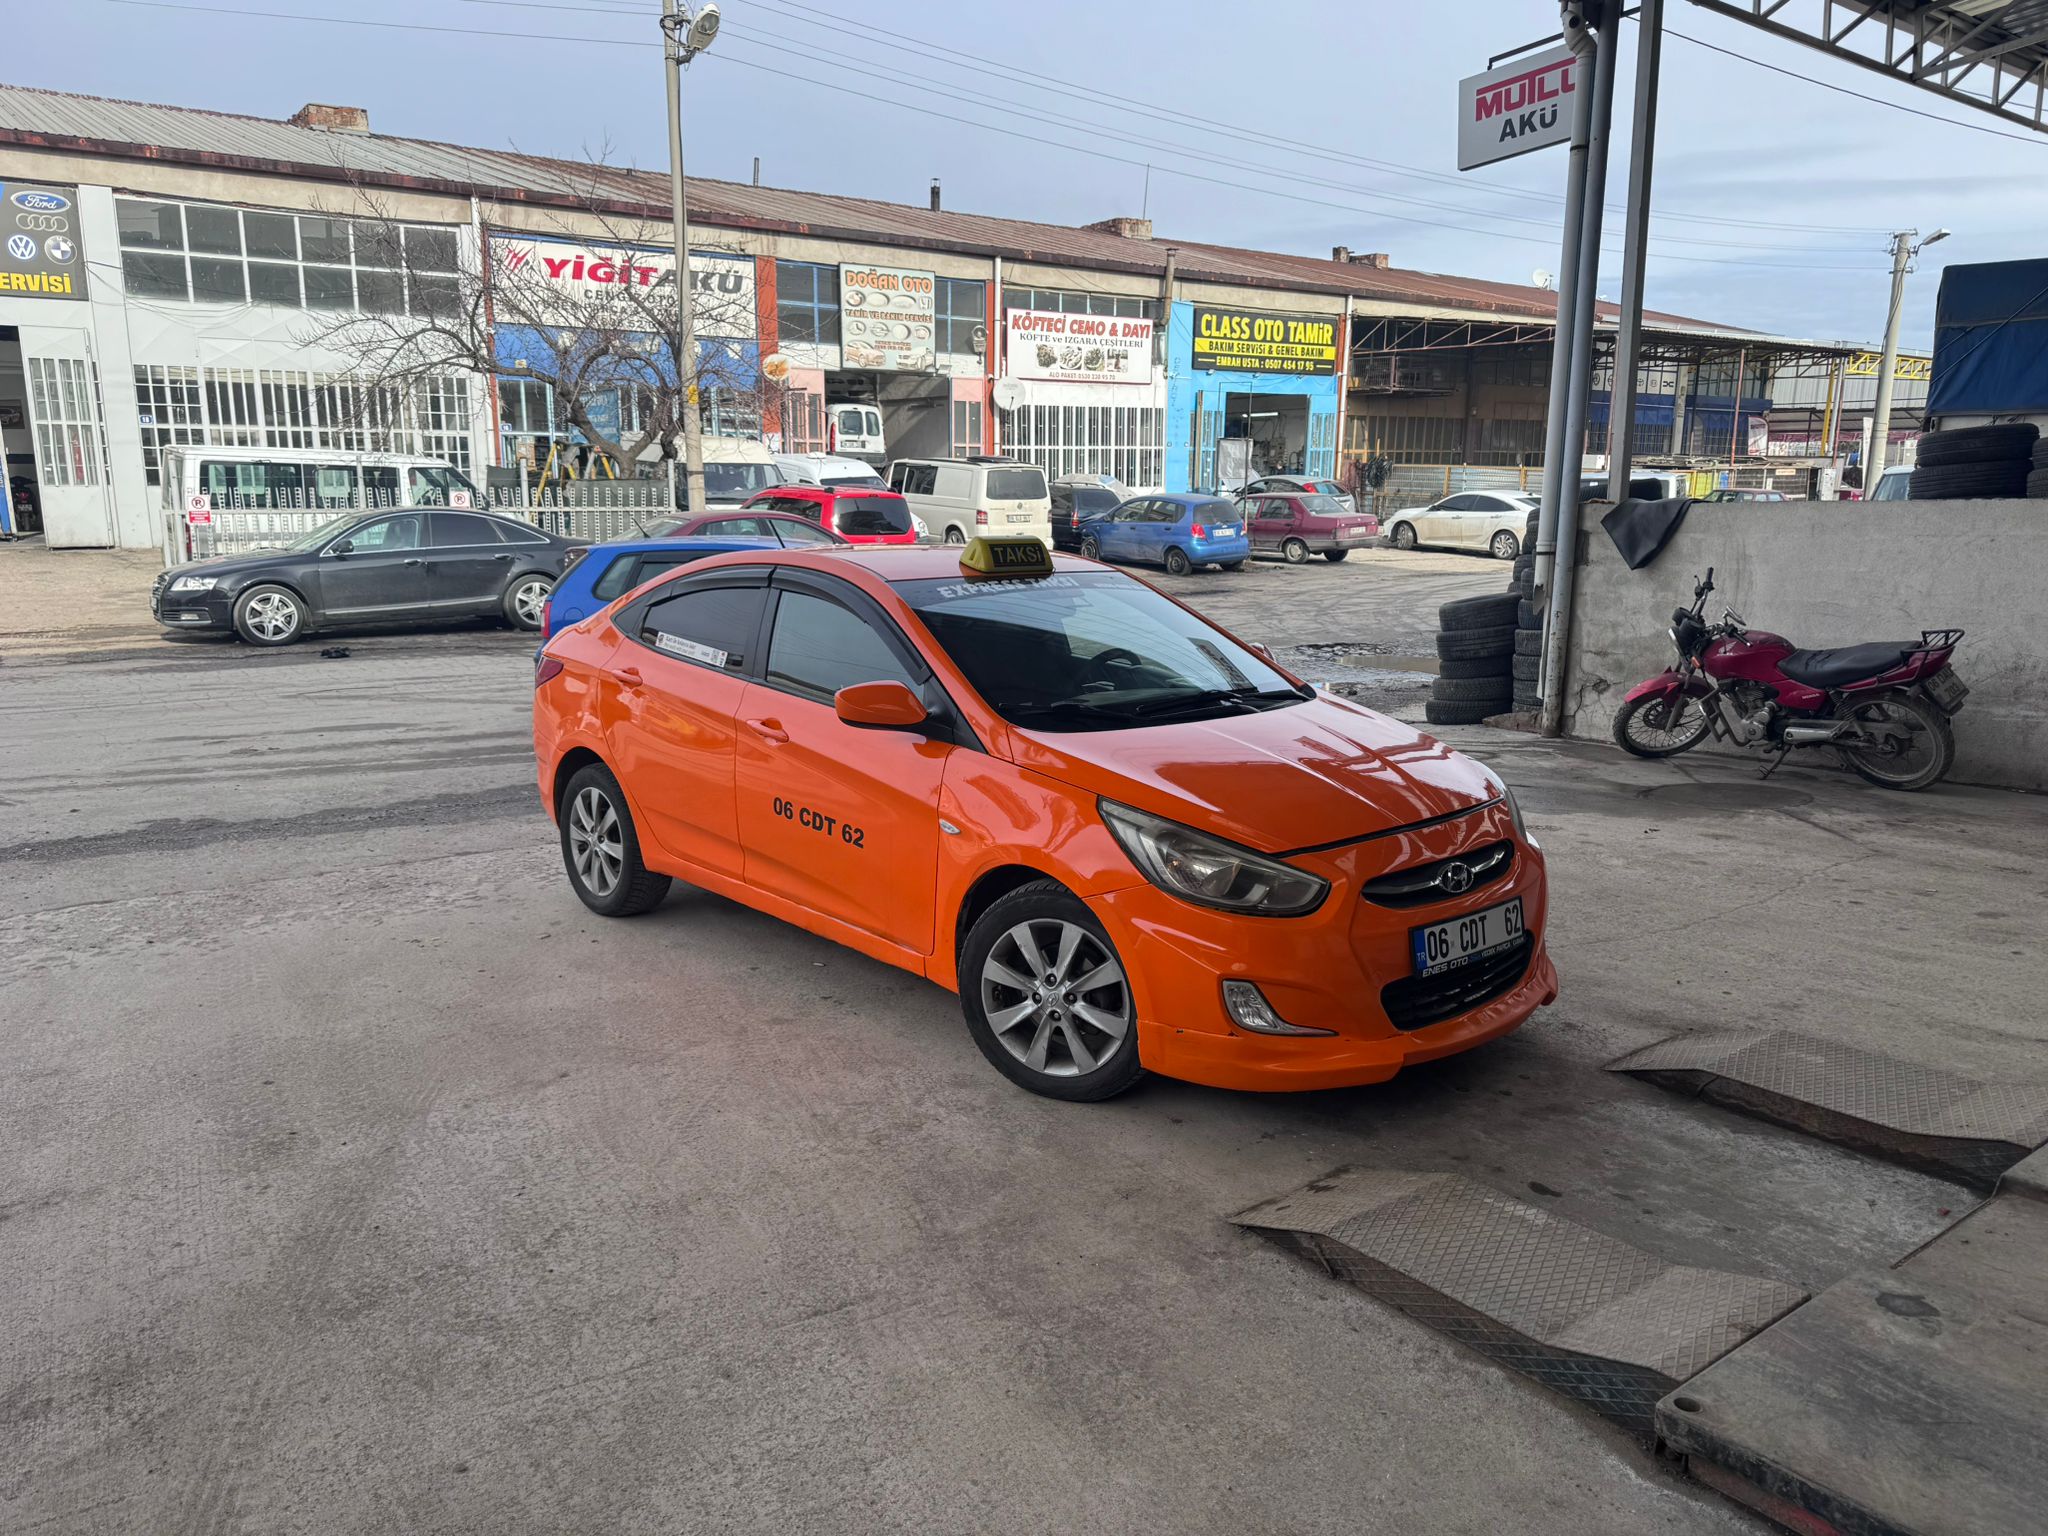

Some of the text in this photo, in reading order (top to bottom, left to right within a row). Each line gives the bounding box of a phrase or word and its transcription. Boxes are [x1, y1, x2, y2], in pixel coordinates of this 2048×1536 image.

[1498, 103, 1558, 143] AKÜ
[25, 194, 57, 209] Ford
[844, 268, 933, 293] DOĞAN OTO
[844, 308, 869, 319] TAMİR
[869, 310, 880, 319] VE
[1011, 312, 1151, 339] KÖFTECİ CEMO & DAYI
[1201, 314, 1250, 340] CLASS
[1253, 318, 1284, 342] OTO
[1019, 332, 1144, 349] KÖFTE ve IZGARA ÇEŞİTLERİ
[1209, 340, 1235, 353] BAKIM
[1268, 346, 1274, 355] &
[1275, 346, 1299, 356] GENEL
[1301, 347, 1324, 357] BAKIM
[1216, 356, 1241, 367] EMRAH
[1242, 358, 1260, 369] USTA
[1265, 359, 1281, 369] 0507
[1282, 360, 1296, 370] 454
[936, 578, 1027, 598] EXPRESS
[773, 797, 865, 849] 06 CDT 62
[1426, 903, 1521, 962] 06 CDT 62
[1416, 951, 1426, 962] TR
[1422, 962, 1448, 978] ENES
[1450, 956, 1469, 969] OTO
